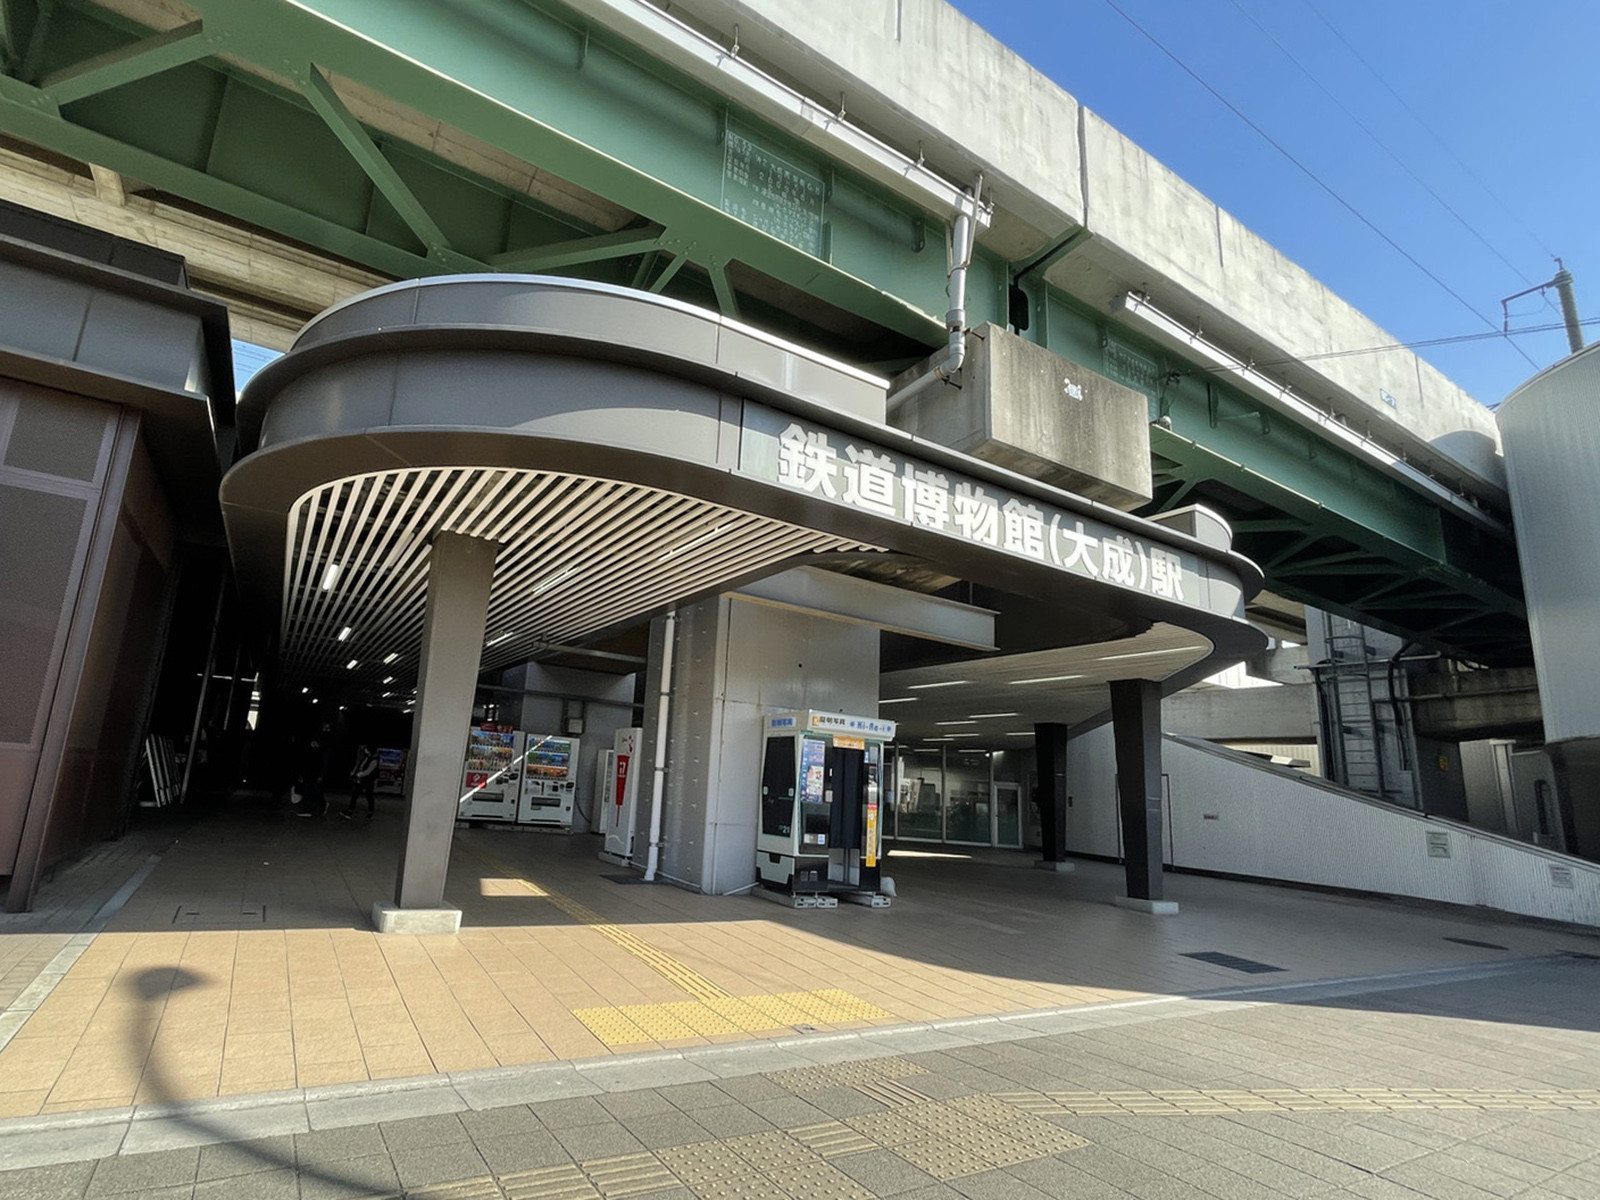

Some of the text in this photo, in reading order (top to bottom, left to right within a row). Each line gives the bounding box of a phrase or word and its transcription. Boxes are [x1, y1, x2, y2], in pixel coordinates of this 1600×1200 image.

[777, 422, 1185, 601] 鉄道博物館(大成)駅
